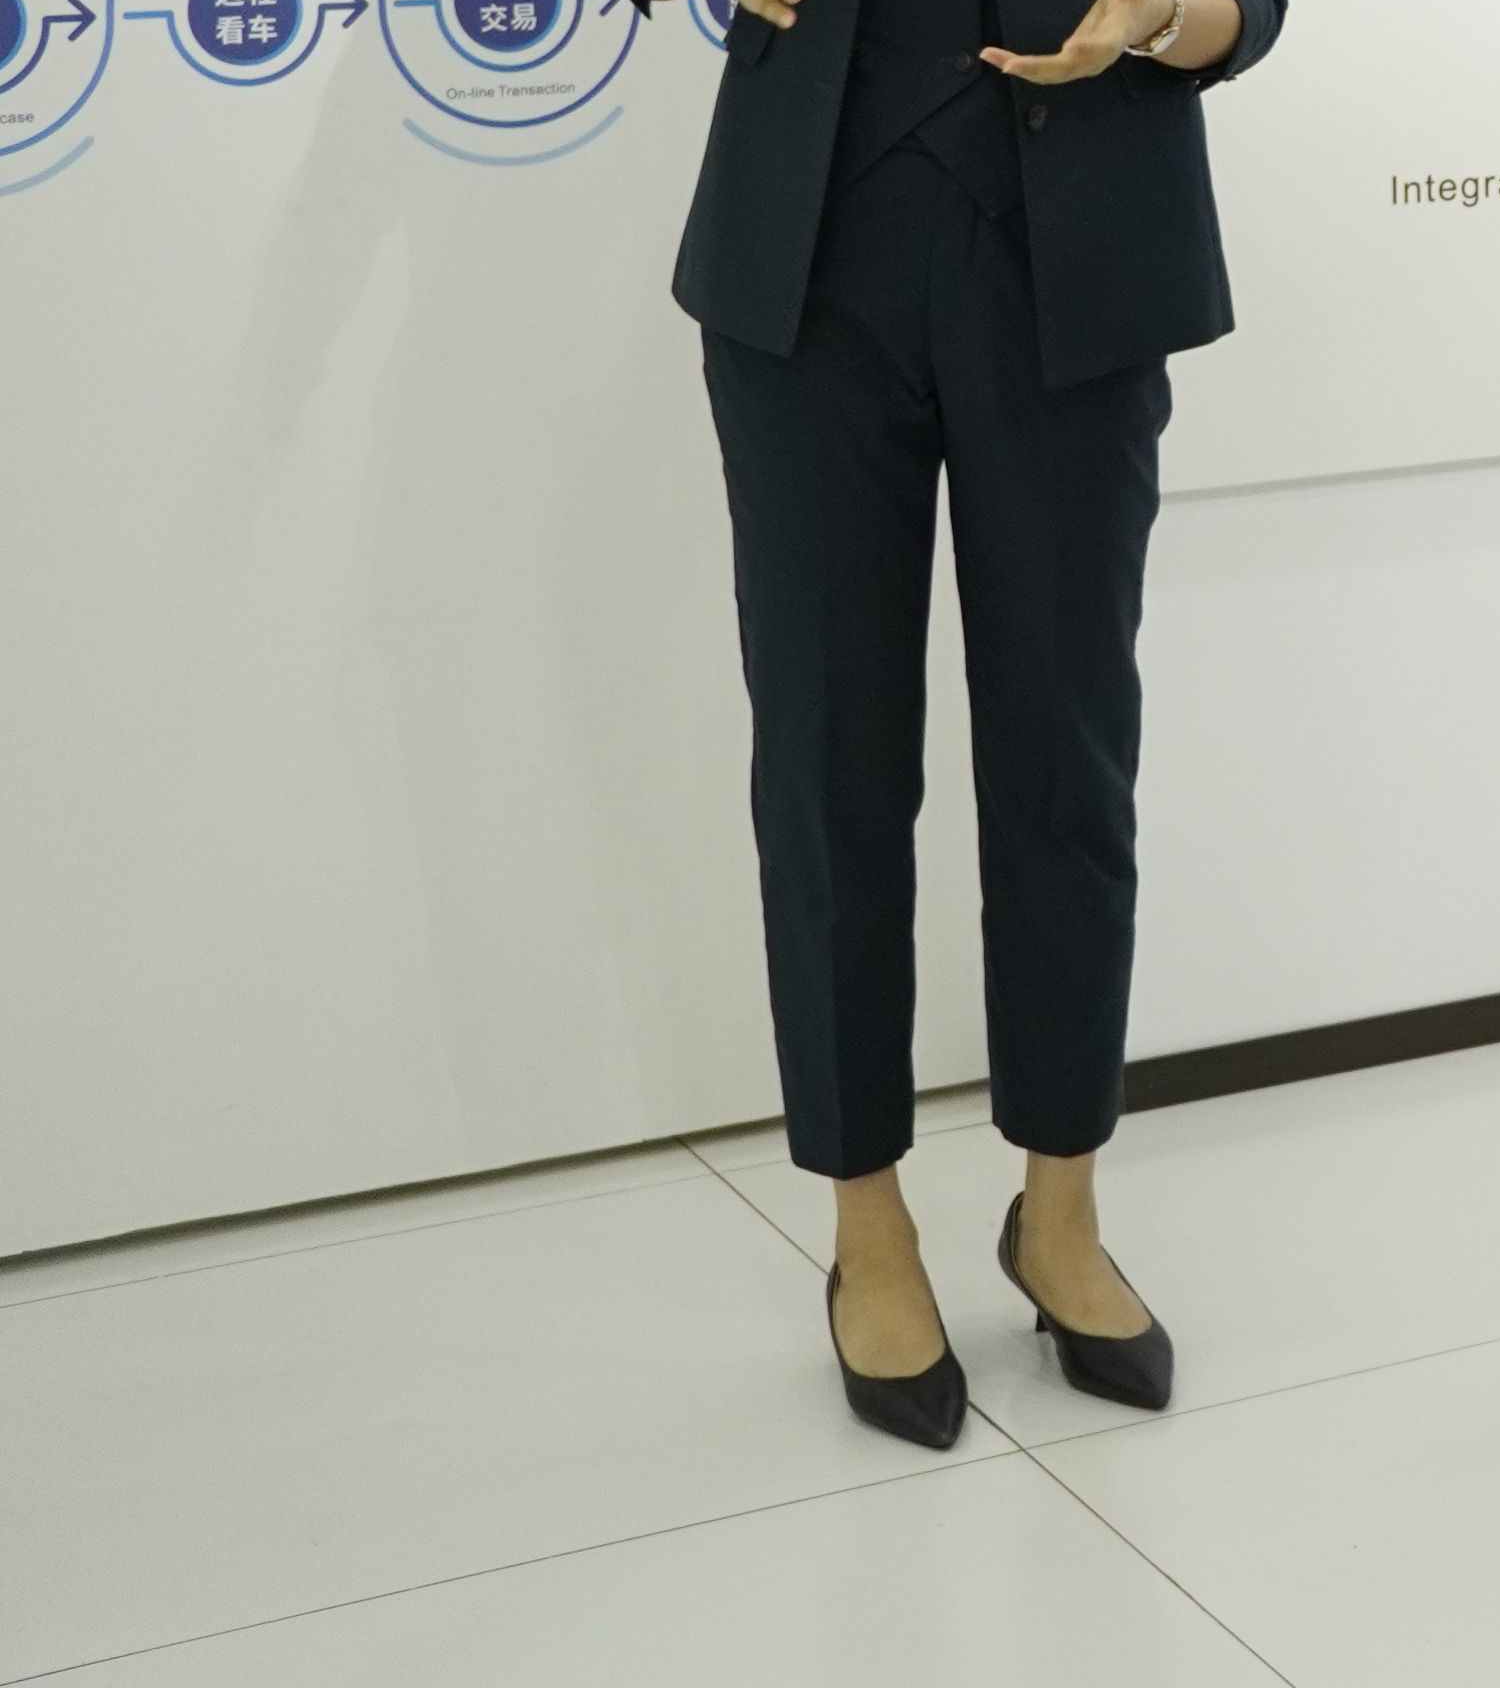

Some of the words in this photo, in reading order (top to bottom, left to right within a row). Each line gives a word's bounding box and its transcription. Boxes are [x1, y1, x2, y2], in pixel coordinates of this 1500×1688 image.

[215, 14, 279, 46] 看车
[479, 3, 537, 33] 交易
[498, 81, 576, 98] Transaction
